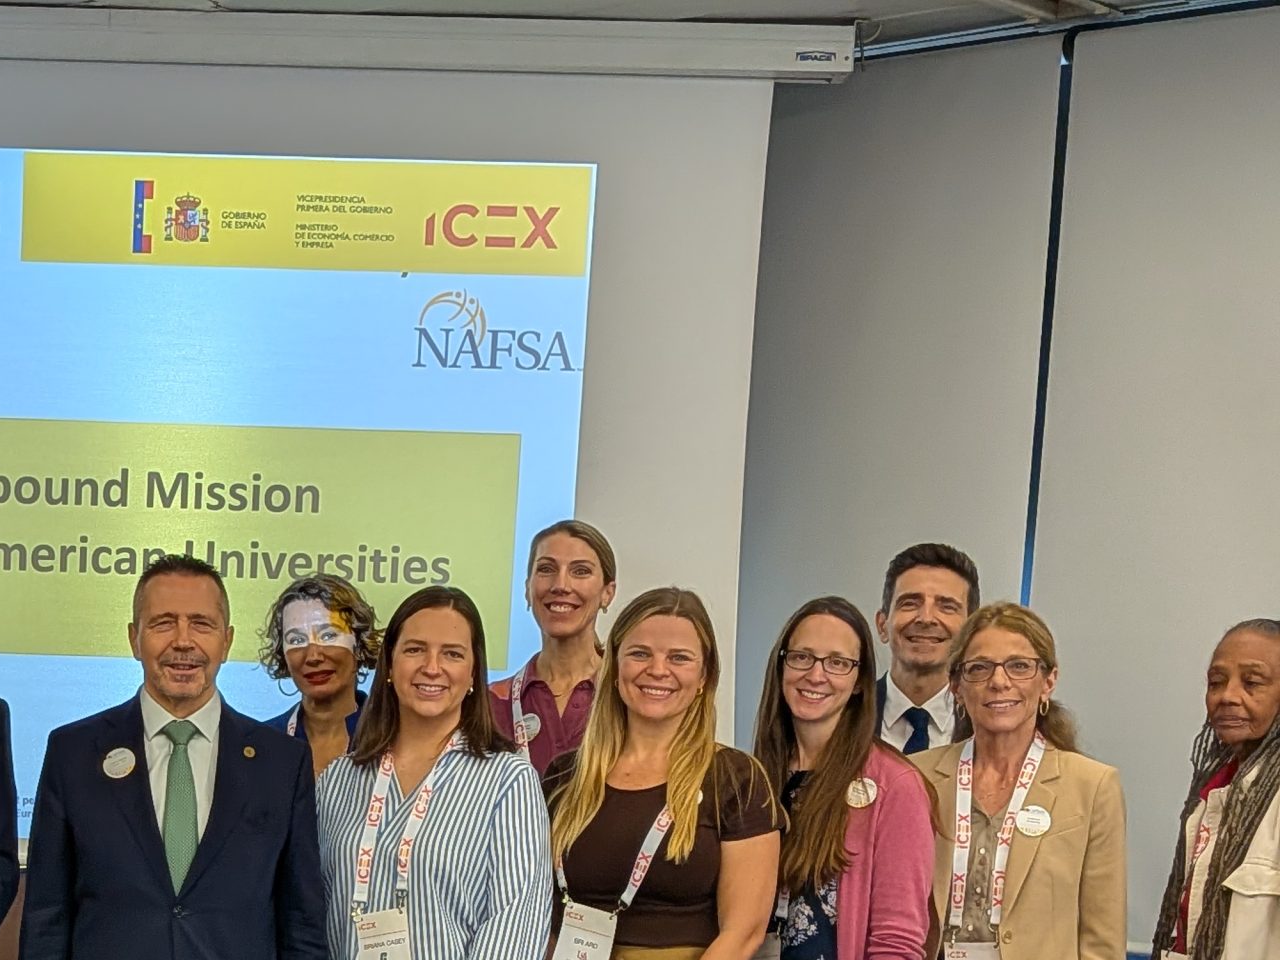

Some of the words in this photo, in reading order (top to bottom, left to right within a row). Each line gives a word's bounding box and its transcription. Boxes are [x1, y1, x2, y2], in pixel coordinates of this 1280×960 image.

[221, 211, 267, 220] GOBIERNO
[296, 204, 330, 213] PRIMERA
[332, 205, 348, 213] DEL
[349, 206, 393, 214] GOBIERNO
[297, 195, 366, 204] VICEPRESIDENCIA
[221, 221, 232, 229] DE
[235, 220, 266, 229] ESPAÑA
[295, 232, 305, 240] DE
[424, 204, 561, 249] ICEX
[412, 327, 576, 372] NAFSA
[146, 470, 321, 515] Mission
[958, 758, 972, 792] ICEX
[1016, 756, 1038, 790] ICEX
[367, 795, 386, 828] ICEX
[415, 785, 432, 820] ICEX
[956, 812, 971, 850] ICEX
[999, 811, 1016, 846] ICEX
[356, 847, 374, 885] ICEX
[630, 851, 652, 888] ICEX
[953, 872, 966, 910] ICEX
[992, 870, 1006, 908] ICEX
